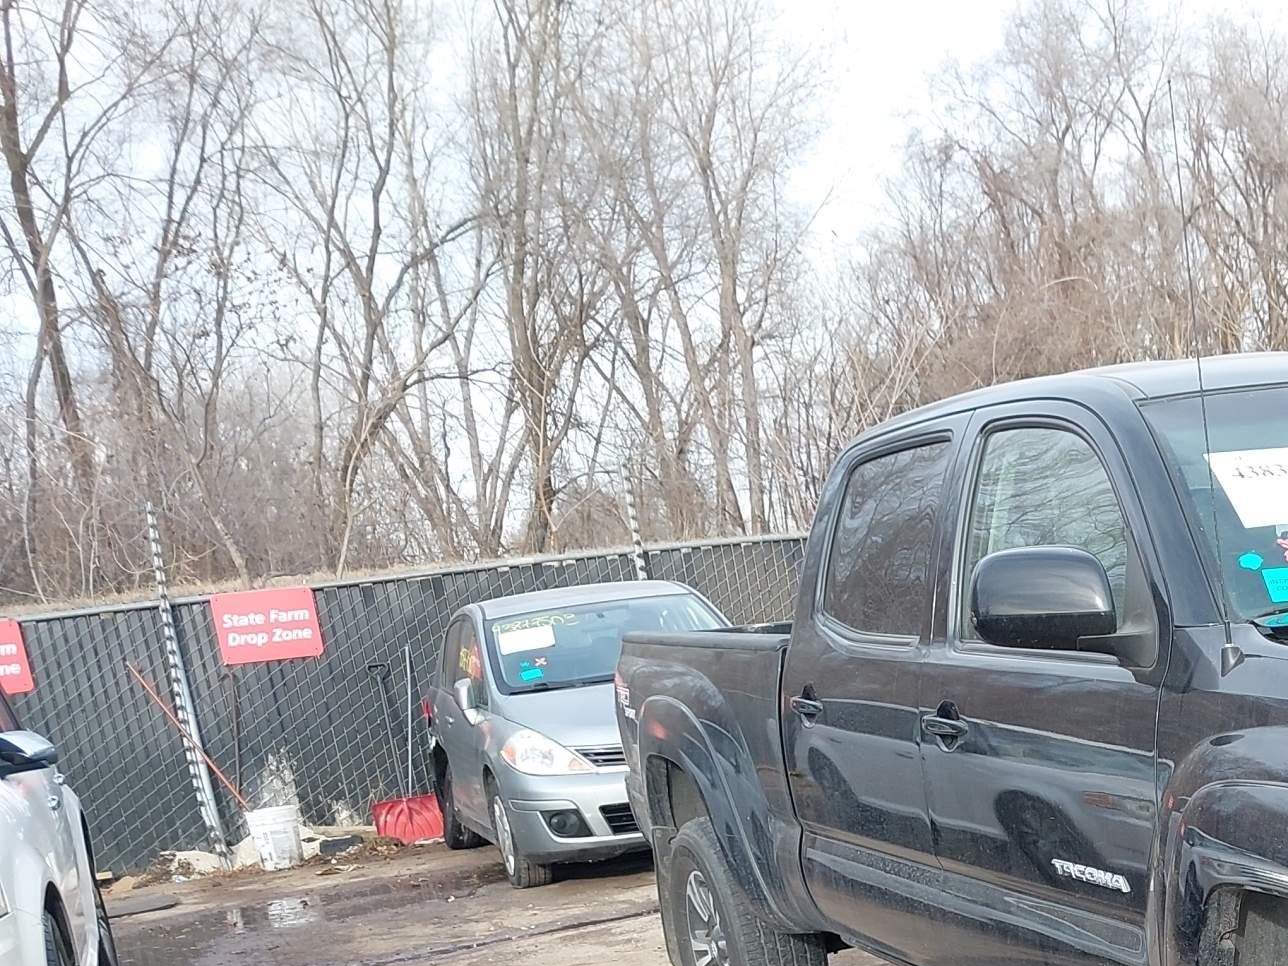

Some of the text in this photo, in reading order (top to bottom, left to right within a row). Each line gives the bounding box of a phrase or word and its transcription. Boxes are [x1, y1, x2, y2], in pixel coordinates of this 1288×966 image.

[222, 608, 310, 628] State Farm
[227, 627, 313, 647] Drop Zone
[0, 663, 21, 677] ne
[1050, 857, 1132, 894] TACOMA
